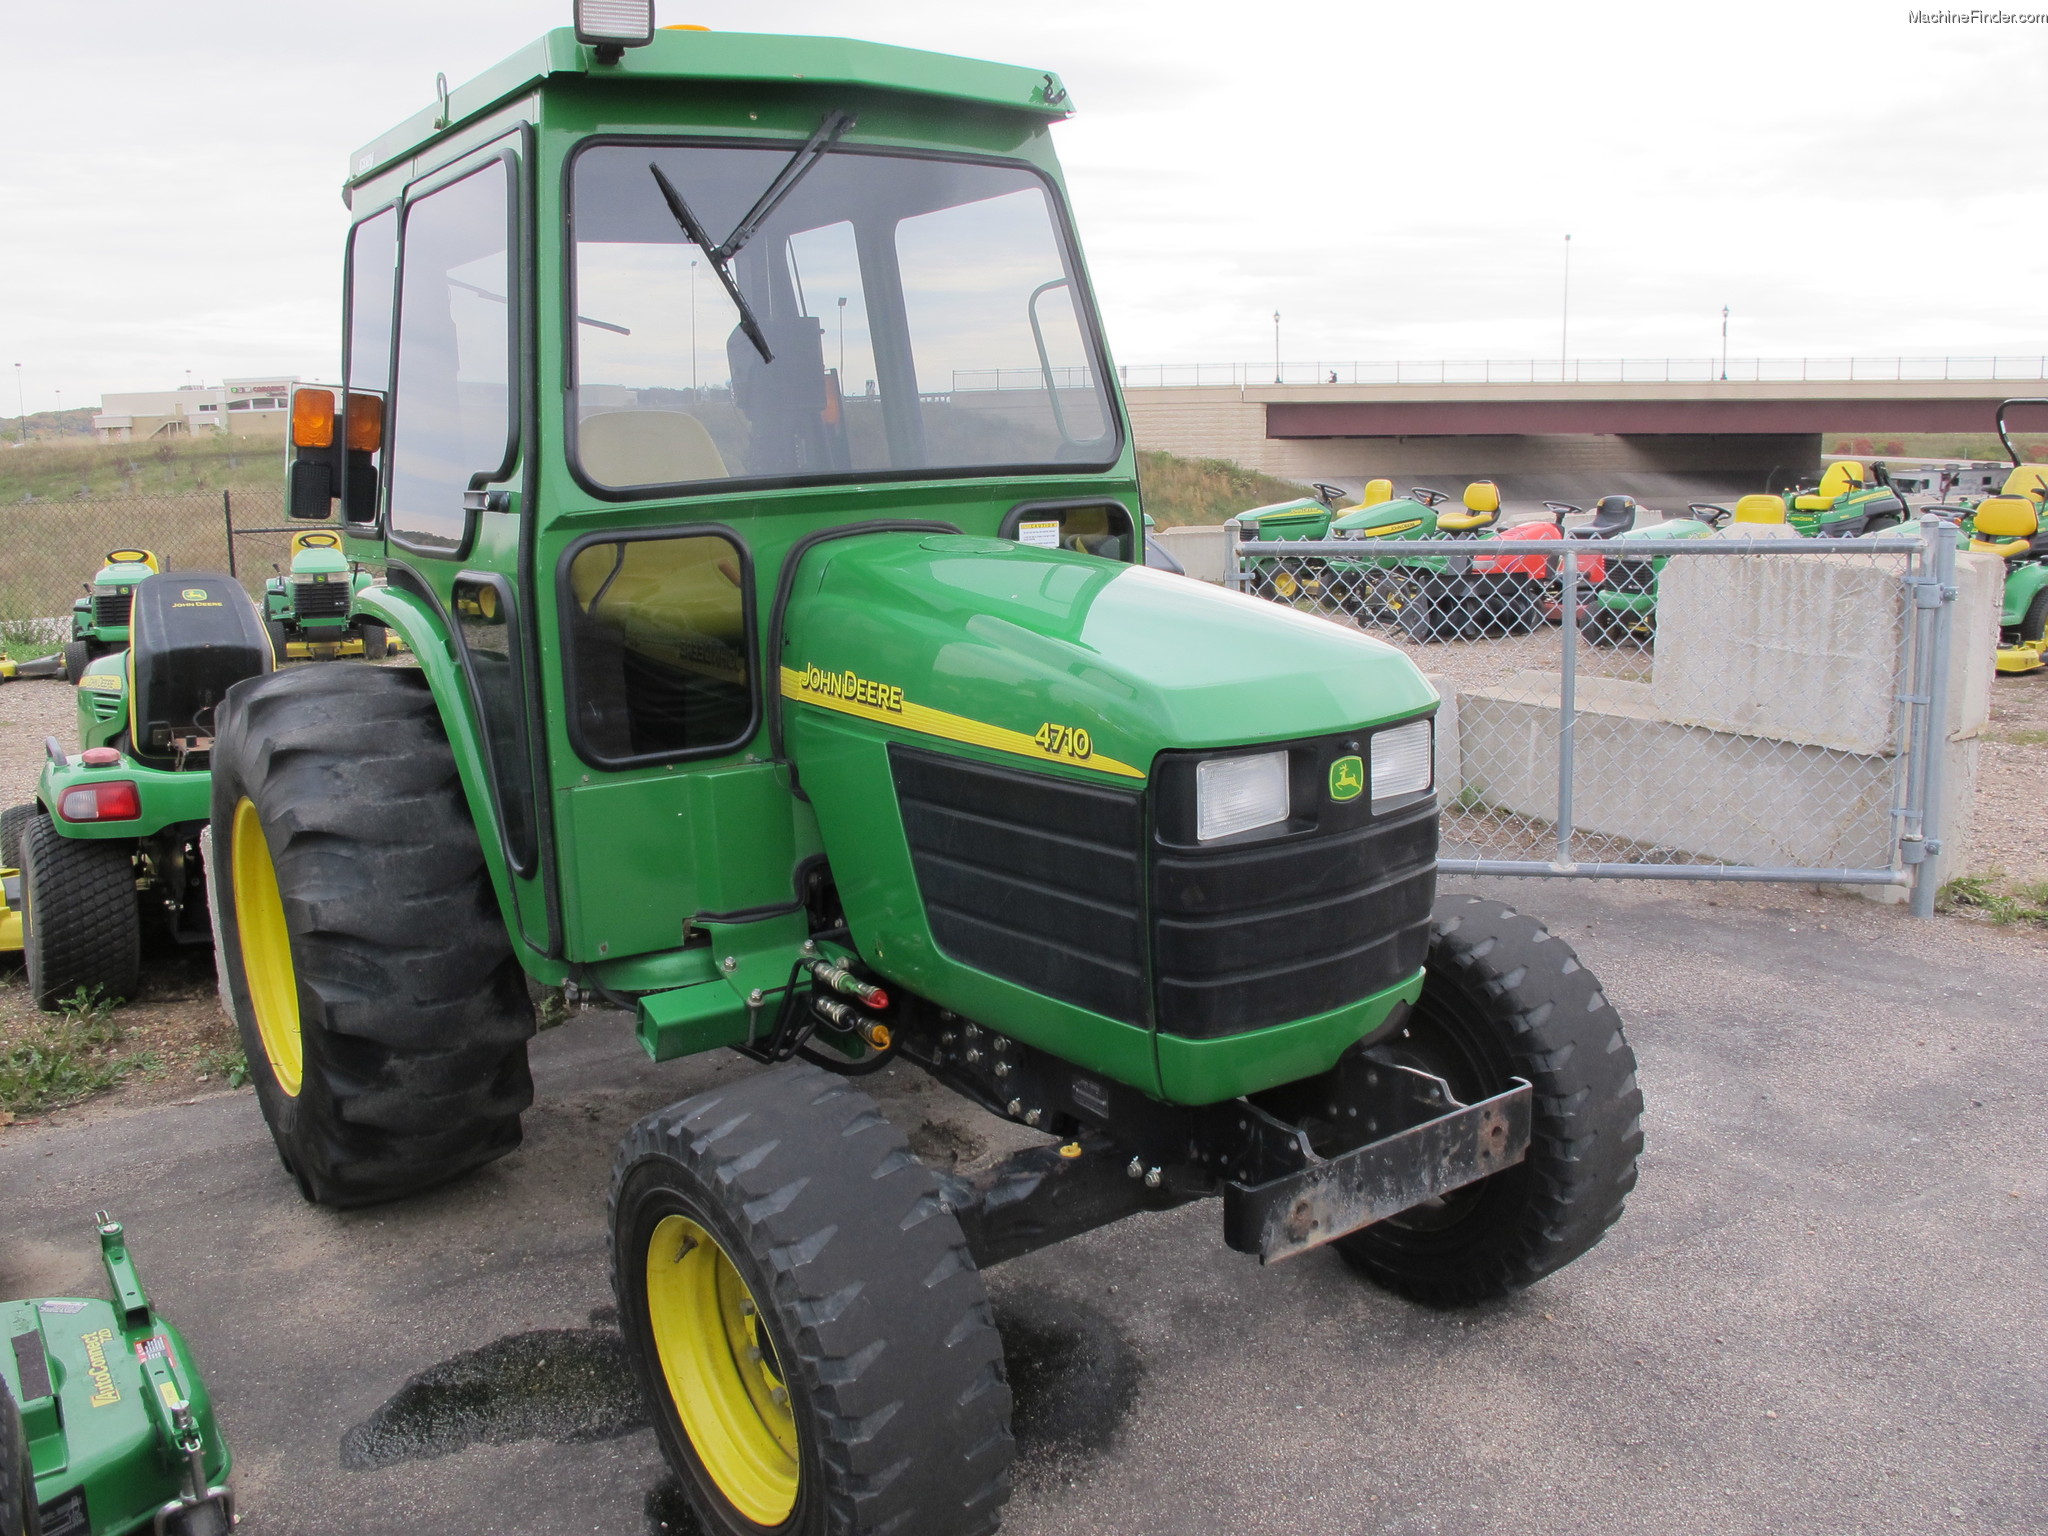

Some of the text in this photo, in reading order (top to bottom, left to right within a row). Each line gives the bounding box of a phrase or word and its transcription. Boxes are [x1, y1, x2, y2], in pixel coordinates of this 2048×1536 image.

[801, 661, 902, 713] JOHN DEERE
[1035, 722, 1091, 759] 4710
[81, 1331, 120, 1401] AutoConnect
